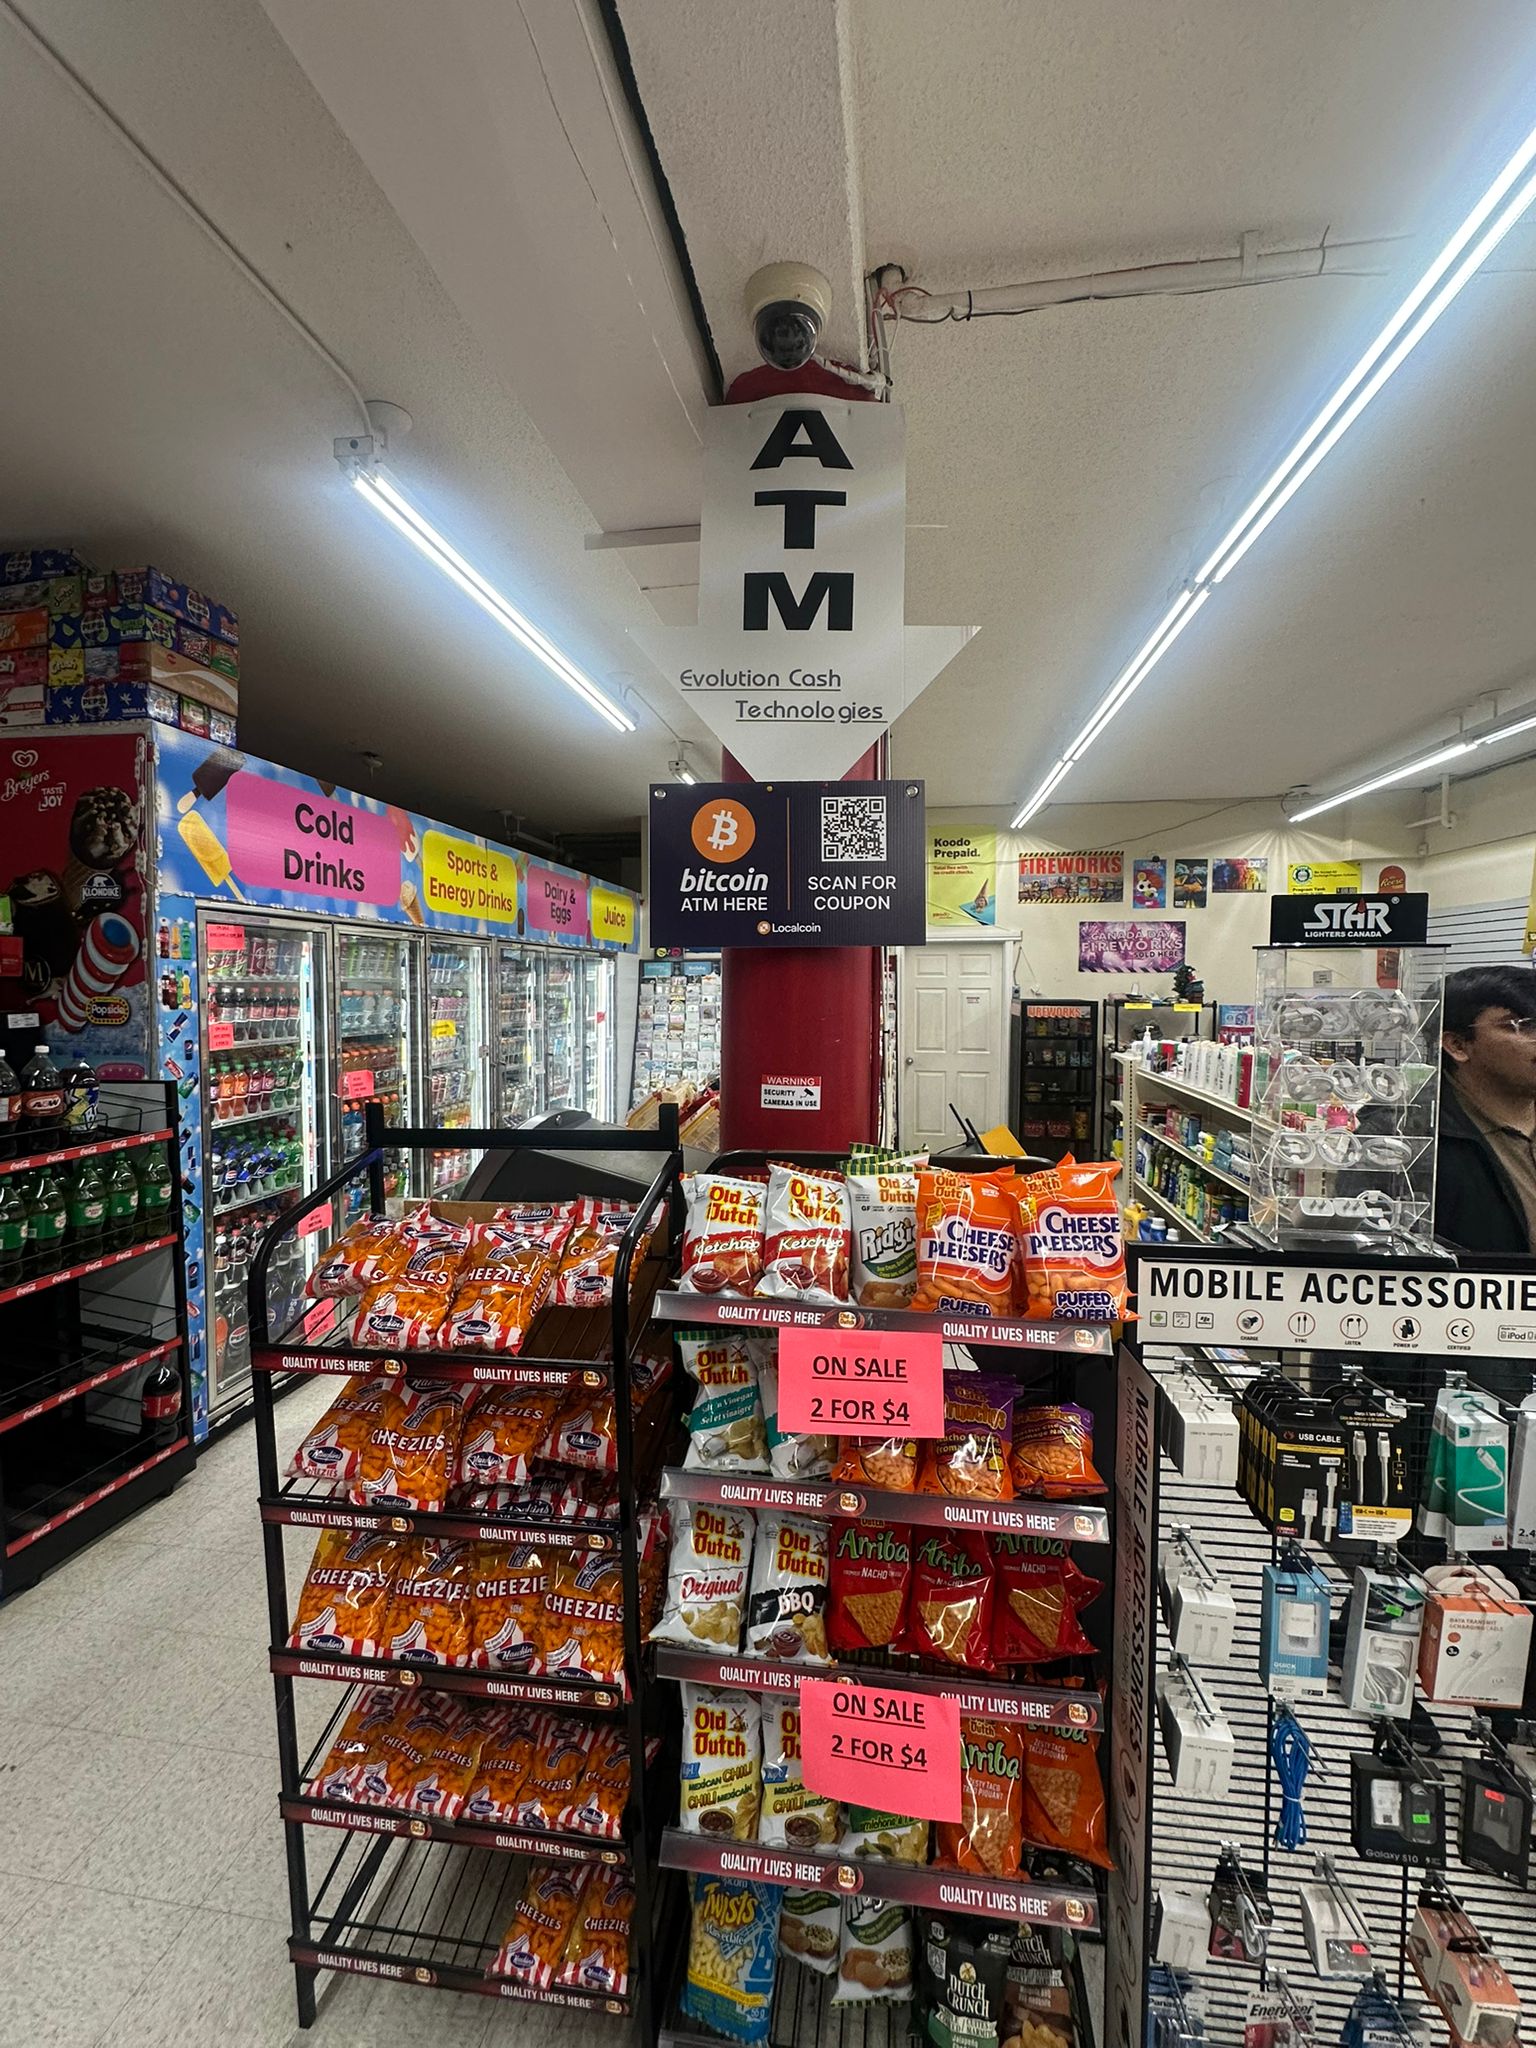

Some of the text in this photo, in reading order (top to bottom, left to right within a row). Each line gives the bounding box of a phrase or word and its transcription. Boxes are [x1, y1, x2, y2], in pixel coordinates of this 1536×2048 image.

[743, 409, 854, 631] ATM
[680, 668, 841, 688] Evolution Cash
[735, 700, 883, 723] Technologies
[1, 771, 50, 801] Breyers
[41, 786, 64, 795] TASTE
[42, 795, 63, 808] JOY
[295, 802, 354, 845] Cold
[934, 838, 970, 847] Koodo
[934, 849, 980, 859] Prepaid.
[284, 849, 365, 892] Drinks
[447, 850, 498, 881] Sports &
[1019, 856, 1122, 876] FIREWORKS
[680, 867, 769, 892] bitcoin
[808, 876, 896, 890] SCAN FOR
[82, 886, 120, 898] KLONDIKE
[430, 877, 512, 912] Energy Drinks
[544, 881, 576, 904] Dairy &
[550, 901, 572, 925] Eggs
[681, 897, 768, 912] ATM HERE
[814, 896, 890, 911] COUPON
[603, 906, 626, 927] Juice
[1303, 902, 1392, 934] STAR
[772, 923, 821, 933] Localcoin
[1091, 930, 1172, 941] CANADA DAY
[1081, 939, 1183, 952] FIREWORKS
[767, 1077, 815, 1086] WARNING
[763, 1099, 794, 1107] CAMERAS
[791, 1179, 822, 1199] Old
[878, 1177, 900, 1188] Old
[936, 1174, 956, 1187] Old
[710, 1186, 741, 1203] Old
[880, 1190, 915, 1202] Dutch
[935, 1186, 969, 1200] Dutch
[707, 1204, 758, 1226] Dutch
[1045, 1212, 1120, 1233] CHEESE
[694, 1237, 760, 1256] Ketchup
[947, 1221, 1014, 1252] CHEESE
[1030, 1234, 1118, 1257] PLEESERS
[928, 1240, 1007, 1272] PLEESERS
[1150, 1267, 1284, 1302] MOBILE
[940, 1297, 991, 1316] PUFFED
[1057, 1291, 1112, 1306] PUFFED
[718, 1306, 760, 1320] QUALITY
[763, 1308, 791, 1322] LIVES
[943, 1323, 988, 1339] QUALITY
[992, 1326, 1023, 1342] LIVES
[1508, 1331, 1526, 1340] iPod
[282, 1356, 318, 1369] QUALITY
[321, 1358, 345, 1371] LIVES
[697, 1350, 727, 1364] Old
[813, 1356, 907, 1378] ON SALE
[473, 1368, 512, 1380] QUALITY
[515, 1369, 540, 1382] LIVES
[699, 1366, 749, 1385] Dutch
[811, 1398, 909, 1424] 2 FOR $4
[371, 1430, 446, 1451] CHEEZIES
[1316, 1435, 1341, 1443] CABLE
[721, 1485, 762, 1499] QUALITY
[765, 1488, 793, 1503] LIVES
[695, 1510, 726, 1534] Old
[944, 1506, 989, 1524] QUALITY
[993, 1511, 1023, 1527] LIVES
[480, 1528, 517, 1541] QUALITY
[520, 1530, 546, 1543] LIVES
[779, 1528, 810, 1551] Old
[836, 1529, 909, 1562] Arriba
[995, 1533, 1065, 1557] Arriba
[693, 1533, 741, 1562] Dutch
[917, 1538, 983, 1576] Arriba
[777, 1550, 825, 1578] Dutch
[861, 1567, 887, 1579] NACHO
[1022, 1562, 1046, 1572] NACHO
[310, 1569, 387, 1587] CHEEZIES
[1129, 1387, 1149, 1763] MOBILE ACCESSORIES
[396, 1578, 470, 1599] CHEEZIES
[682, 1572, 744, 1600] Original
[545, 1593, 624, 1622] CHEEZIES
[778, 1591, 814, 1614] BBQ
[720, 1666, 761, 1683] QUALITY
[763, 1670, 791, 1686] LIVES
[833, 1692, 925, 1723] ON SALE
[988, 1699, 1018, 1715] LIVES
[695, 1708, 727, 1731] Old
[381, 1734, 425, 1764] CHEEZIES
[693, 1732, 746, 1757] Dutch
[831, 1735, 927, 1768] 2 FOR $4
[529, 1778, 572, 1791] CHEEZIES
[720, 1852, 762, 1872] QUALITY
[765, 1858, 792, 1878] LIVES
[1366, 1849, 1418, 1864] Galaxy S10
[940, 1885, 984, 1904] QUALITY
[986, 1892, 1016, 1911] LIVES
[515, 1900, 562, 1930] CHEEZIES
[584, 1916, 631, 1935] CHEEZIES
[317, 1953, 352, 1970] QUALITY
[354, 1958, 377, 1974] LIVES
[950, 1973, 986, 2000] DUTCH
[947, 1987, 990, 2018] CRUNCH
[1250, 2004, 1314, 2017] Energizer
